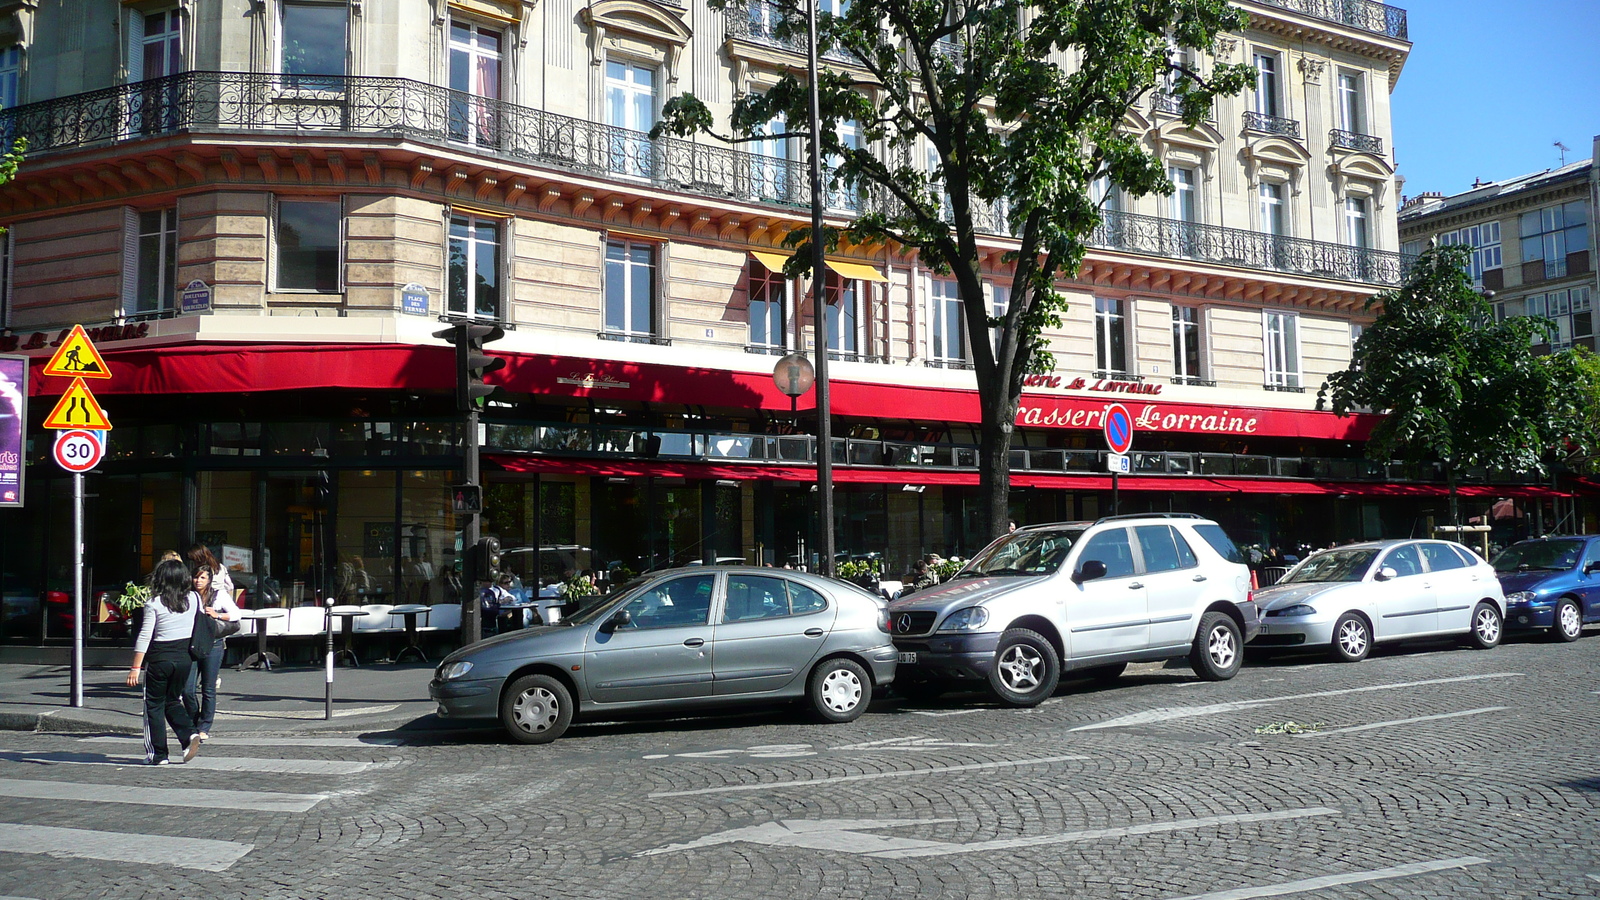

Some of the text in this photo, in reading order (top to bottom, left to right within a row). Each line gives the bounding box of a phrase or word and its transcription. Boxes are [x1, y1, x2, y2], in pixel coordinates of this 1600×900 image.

[1088, 377, 1162, 395] Lorraine
[1016, 405, 1105, 427] rasseri
[66, 443, 90, 458] 30
